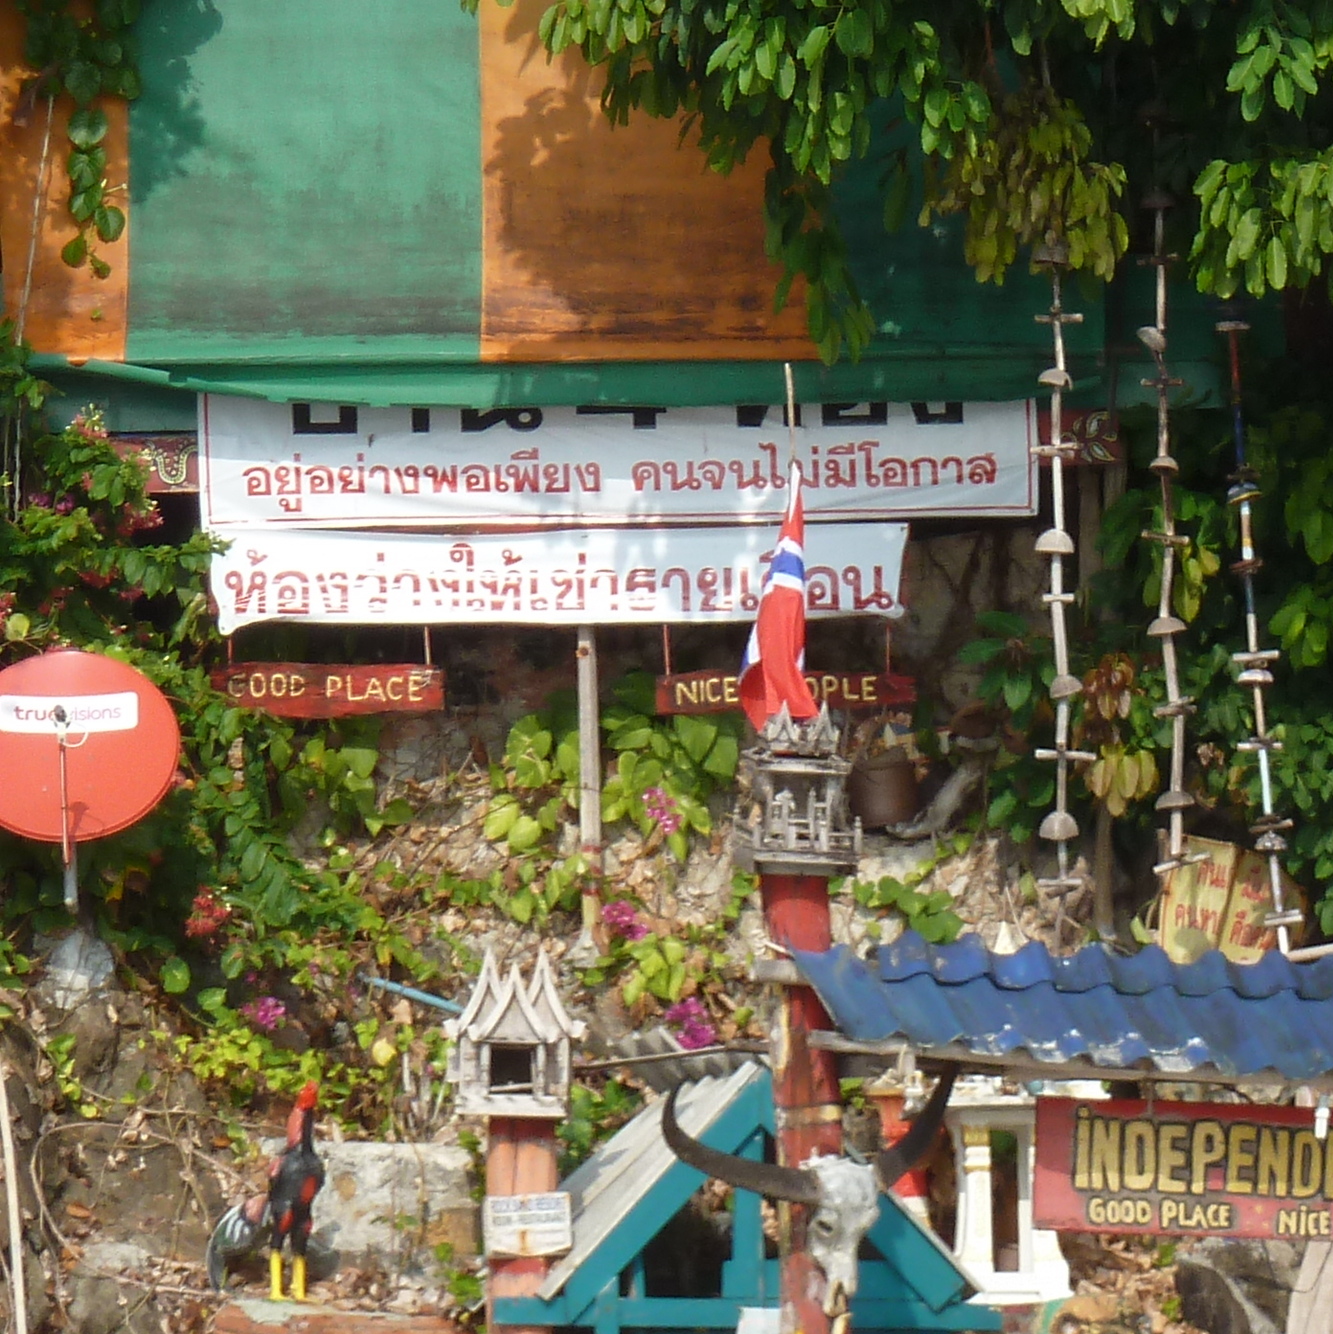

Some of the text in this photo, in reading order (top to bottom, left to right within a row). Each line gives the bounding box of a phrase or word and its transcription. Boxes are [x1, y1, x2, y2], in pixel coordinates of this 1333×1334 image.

[242, 440, 998, 513] อยู่อย่างพอเพียง คนจนไม่มีโอกาส
[224, 542, 893, 615] ห้องว่างให้เช่ารายเอน
[228, 672, 424, 702] GOOD PLACE
[675, 677, 739, 705] NICE
[1088, 1197, 1152, 1225] GOOD
[1160, 1199, 1232, 1229] PLACE
